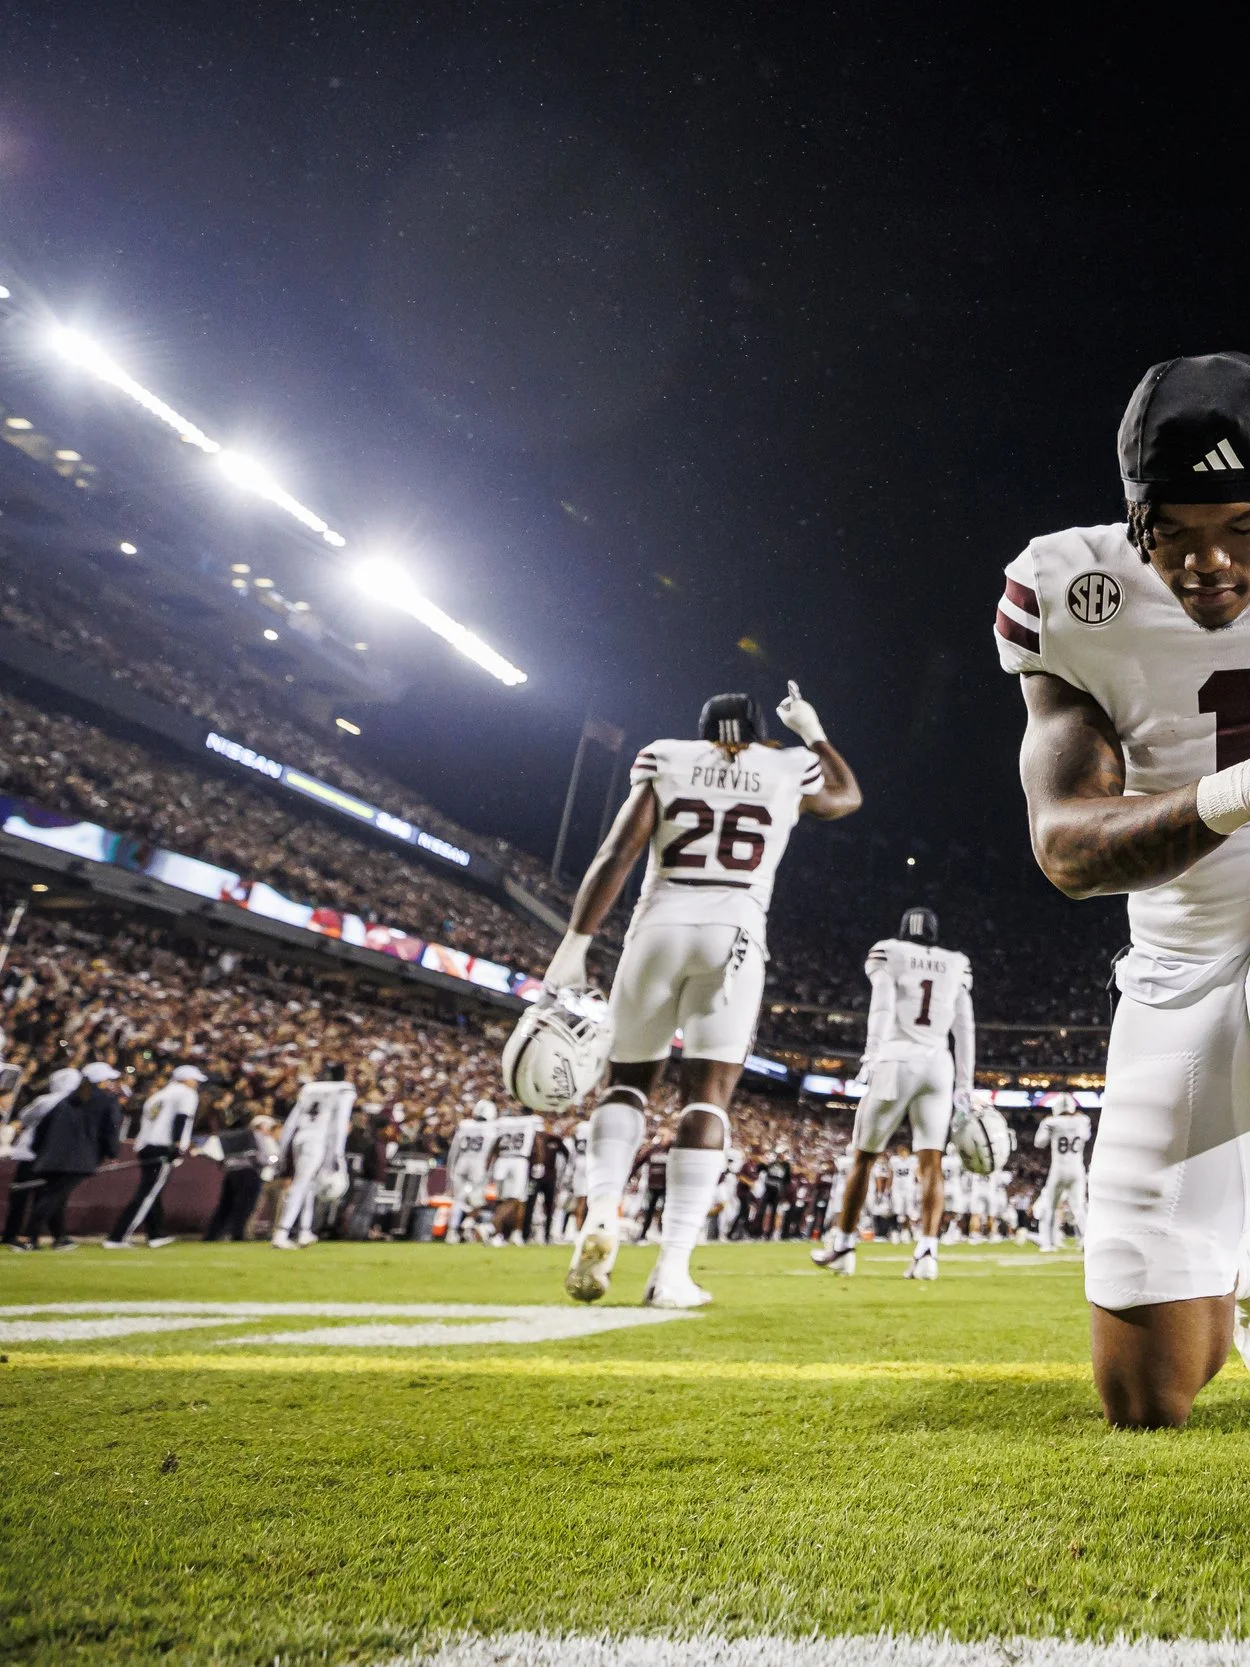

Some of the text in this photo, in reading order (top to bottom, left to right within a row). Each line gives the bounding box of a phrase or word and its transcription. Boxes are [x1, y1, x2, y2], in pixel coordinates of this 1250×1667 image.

[1070, 573, 1119, 623] SEC
[690, 766, 762, 793] PURVIS
[662, 798, 773, 872] 26
[910, 957, 947, 974] BANKS
[914, 979, 934, 1026] 1
